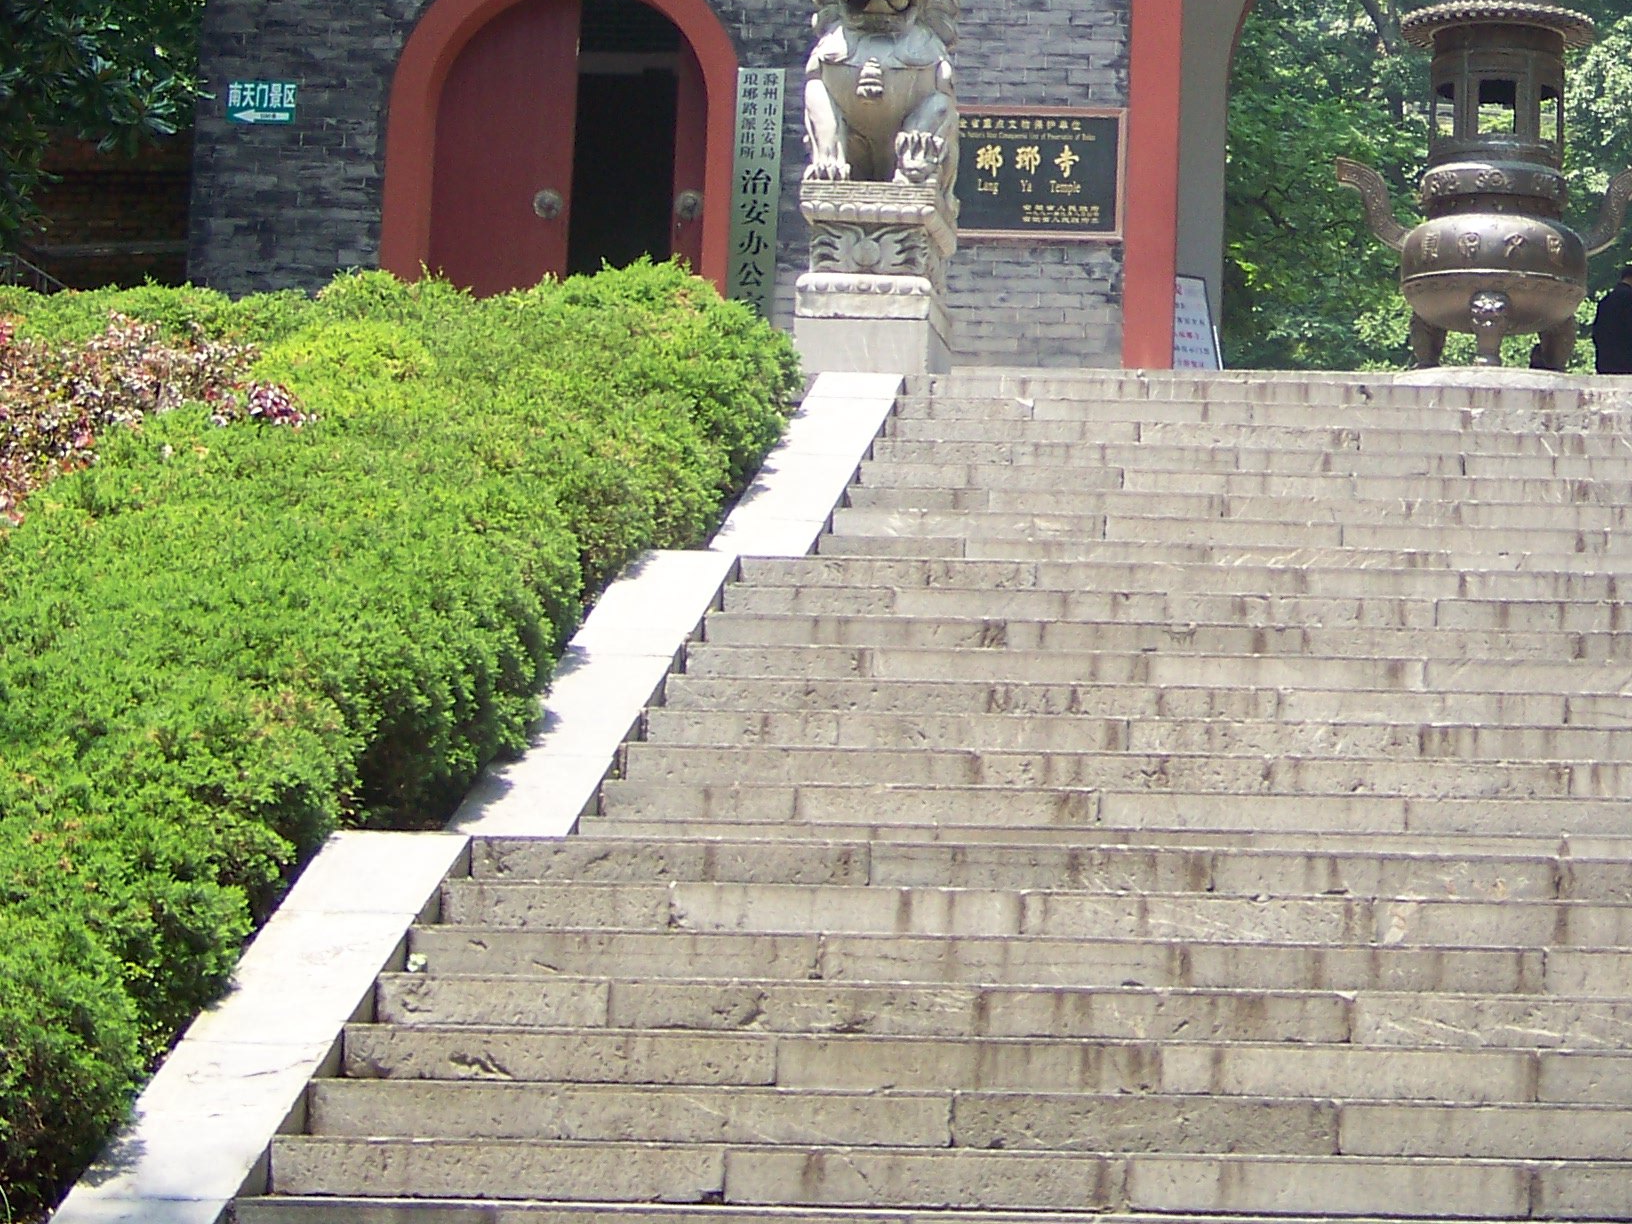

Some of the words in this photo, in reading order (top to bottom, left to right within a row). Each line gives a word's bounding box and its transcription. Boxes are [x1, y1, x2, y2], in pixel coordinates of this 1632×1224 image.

[228, 82, 297, 108] 南天门景区
[761, 73, 779, 160] 滁州市公安局
[978, 178, 999, 195] Lang
[1020, 179, 1033, 192] Ya
[1049, 179, 1081, 196] Temple
